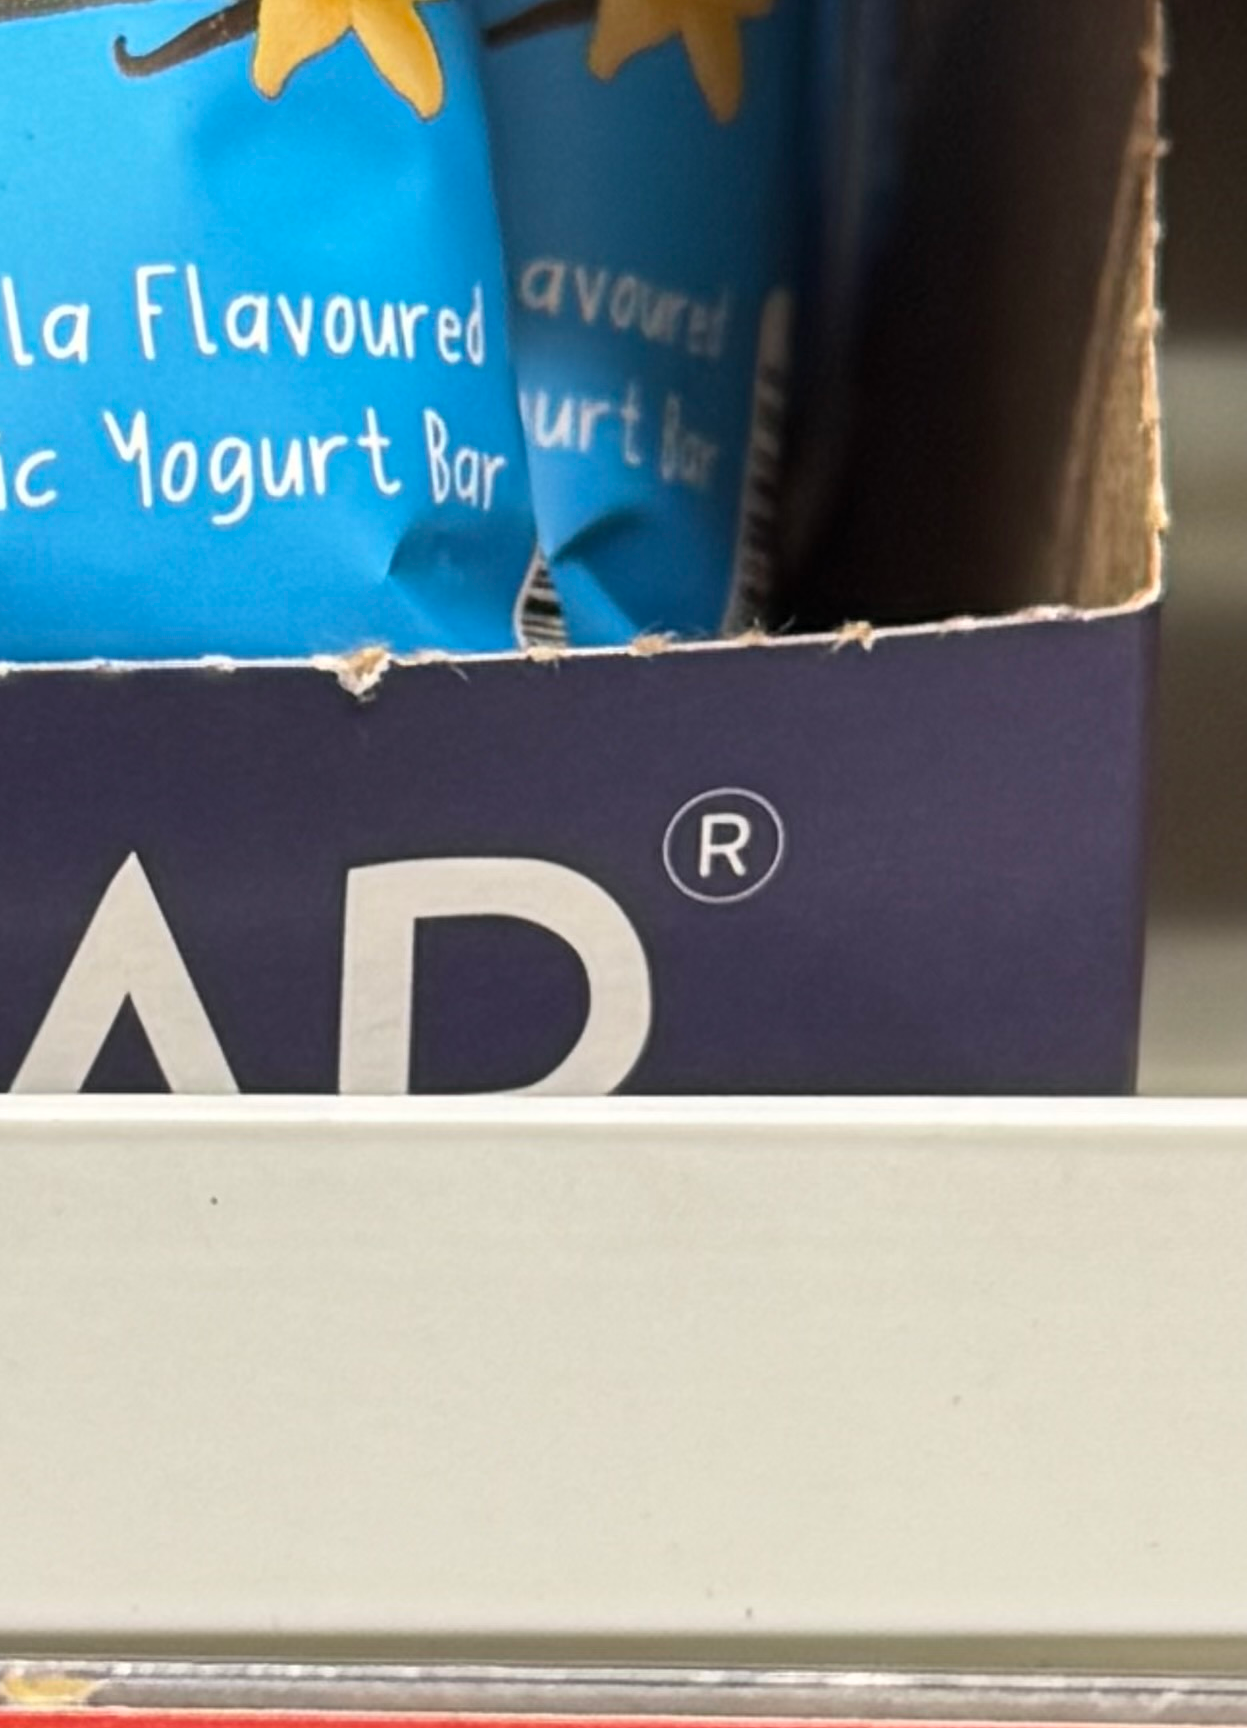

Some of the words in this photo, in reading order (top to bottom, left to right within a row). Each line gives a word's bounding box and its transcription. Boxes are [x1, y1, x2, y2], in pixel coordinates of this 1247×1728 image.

[134, 264, 487, 366] Flavoured
[103, 407, 402, 527] Yogurt
[423, 408, 507, 511] Bar
